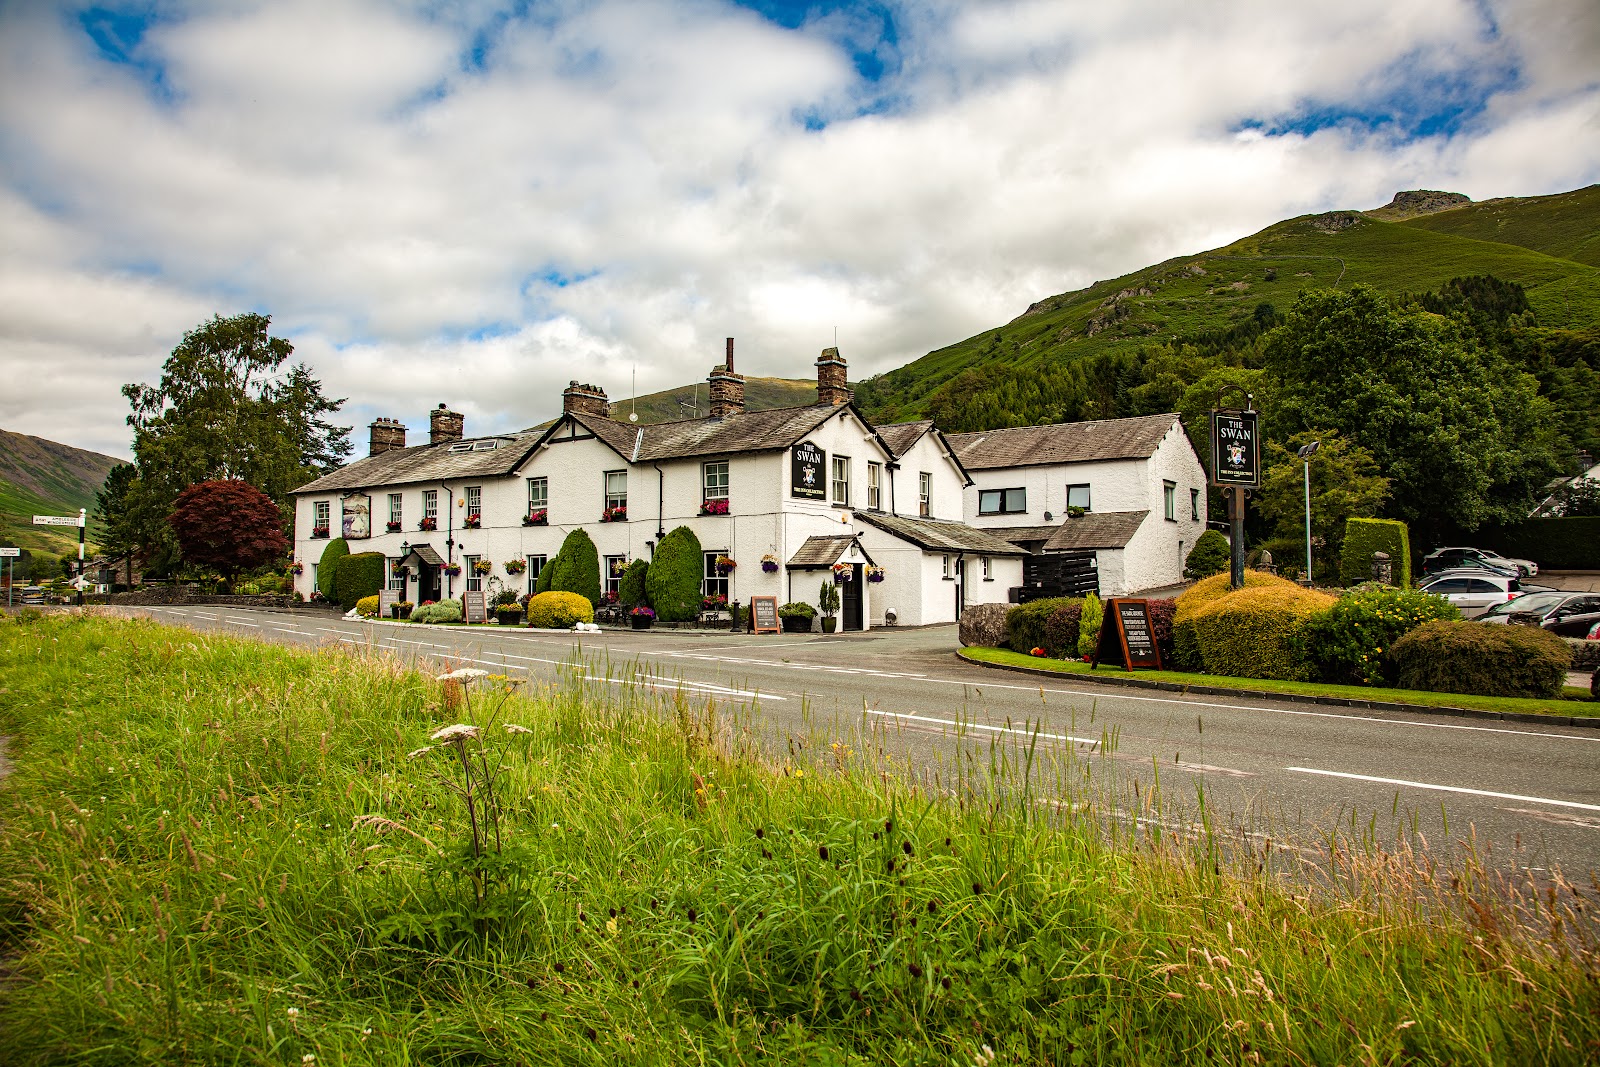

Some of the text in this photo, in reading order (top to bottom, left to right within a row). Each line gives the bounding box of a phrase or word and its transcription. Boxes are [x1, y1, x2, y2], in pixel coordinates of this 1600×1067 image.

[1228, 420, 1243, 429] THE
[1220, 427, 1251, 441] SWAN
[803, 443, 815, 453] THE
[796, 449, 821, 464] SWAN
